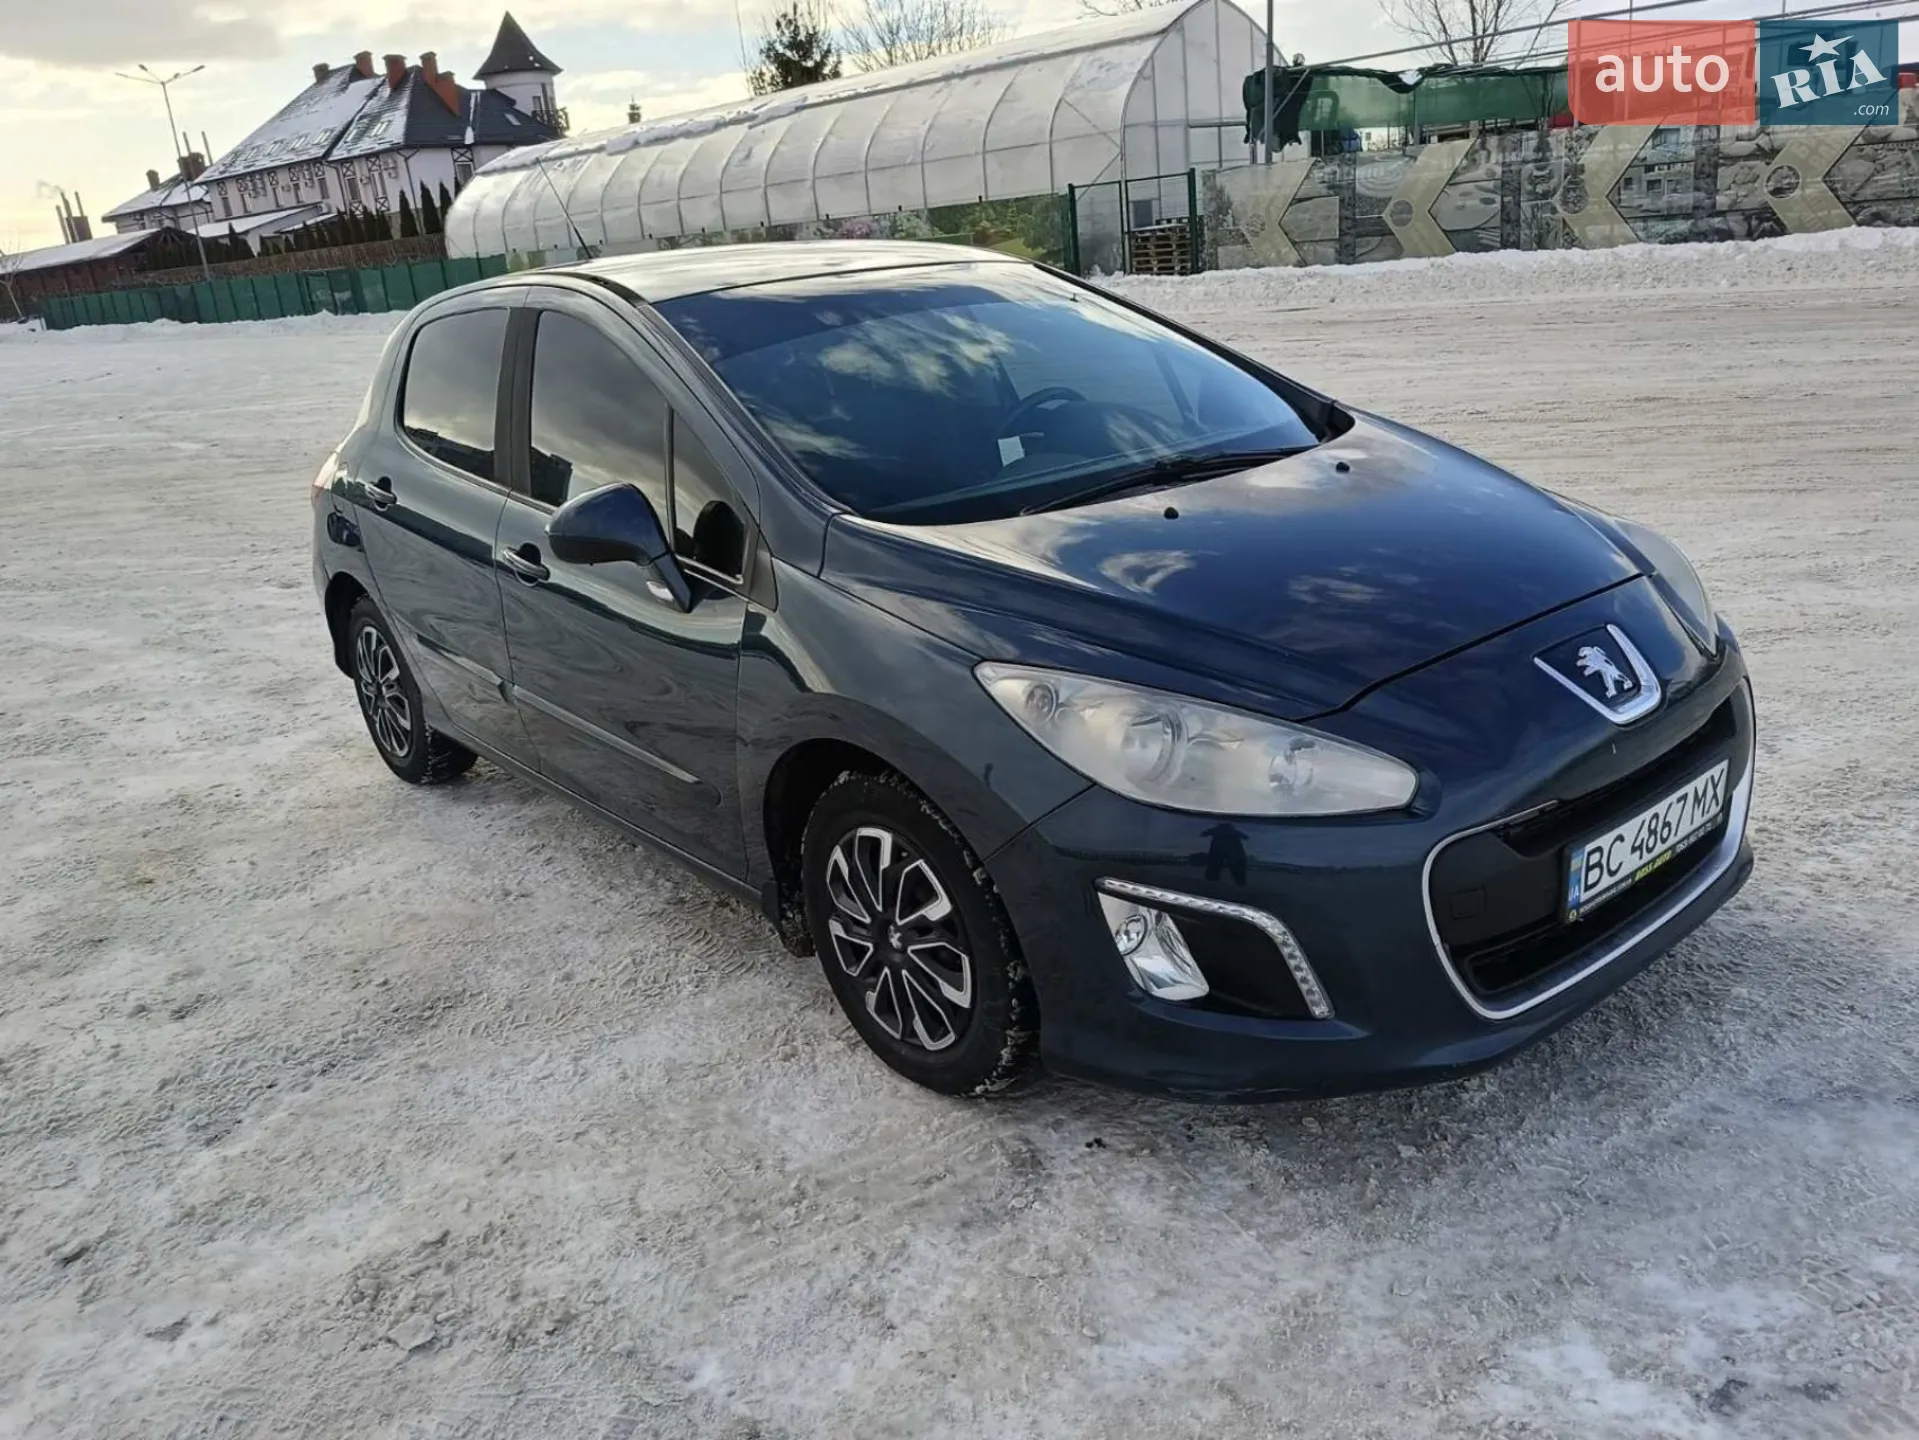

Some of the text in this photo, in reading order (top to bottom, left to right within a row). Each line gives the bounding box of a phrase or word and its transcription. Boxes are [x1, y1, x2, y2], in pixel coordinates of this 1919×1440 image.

[1584, 833, 1625, 893] BC
[1631, 792, 1689, 860] 4867
[1690, 768, 1725, 825] MX
